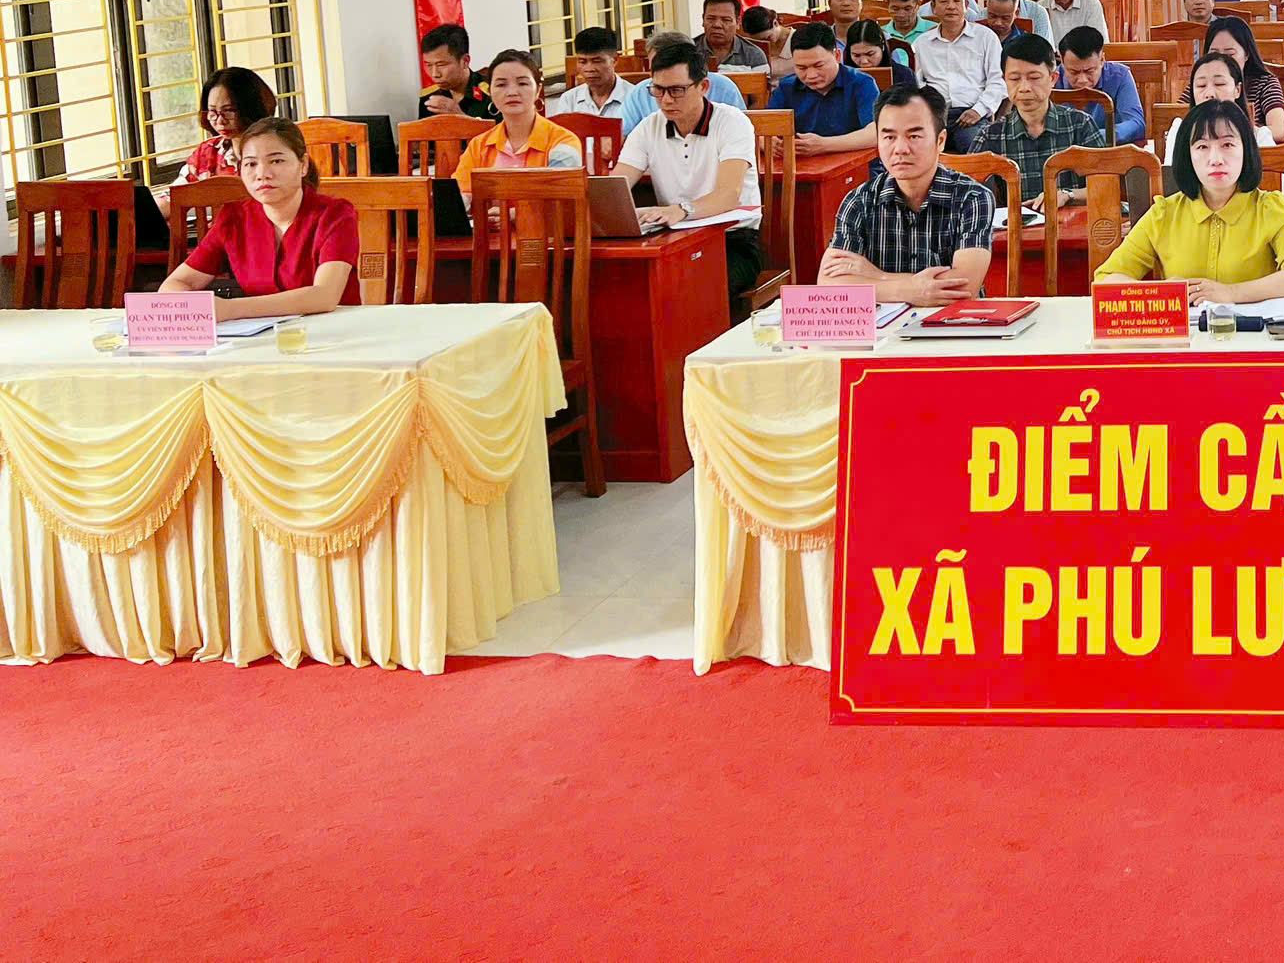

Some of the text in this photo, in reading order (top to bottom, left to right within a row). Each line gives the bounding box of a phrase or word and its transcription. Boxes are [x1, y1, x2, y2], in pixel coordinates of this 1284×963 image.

[840, 306, 872, 314] CHUNG
[1098, 296, 1182, 315] PHẠM THỊ THU HÀ
[157, 314, 172, 324] THỊ
[967, 388, 1169, 513] ĐIỂM
[868, 548, 976, 656] XÃ
[1003, 546, 1162, 657] PHÚ
